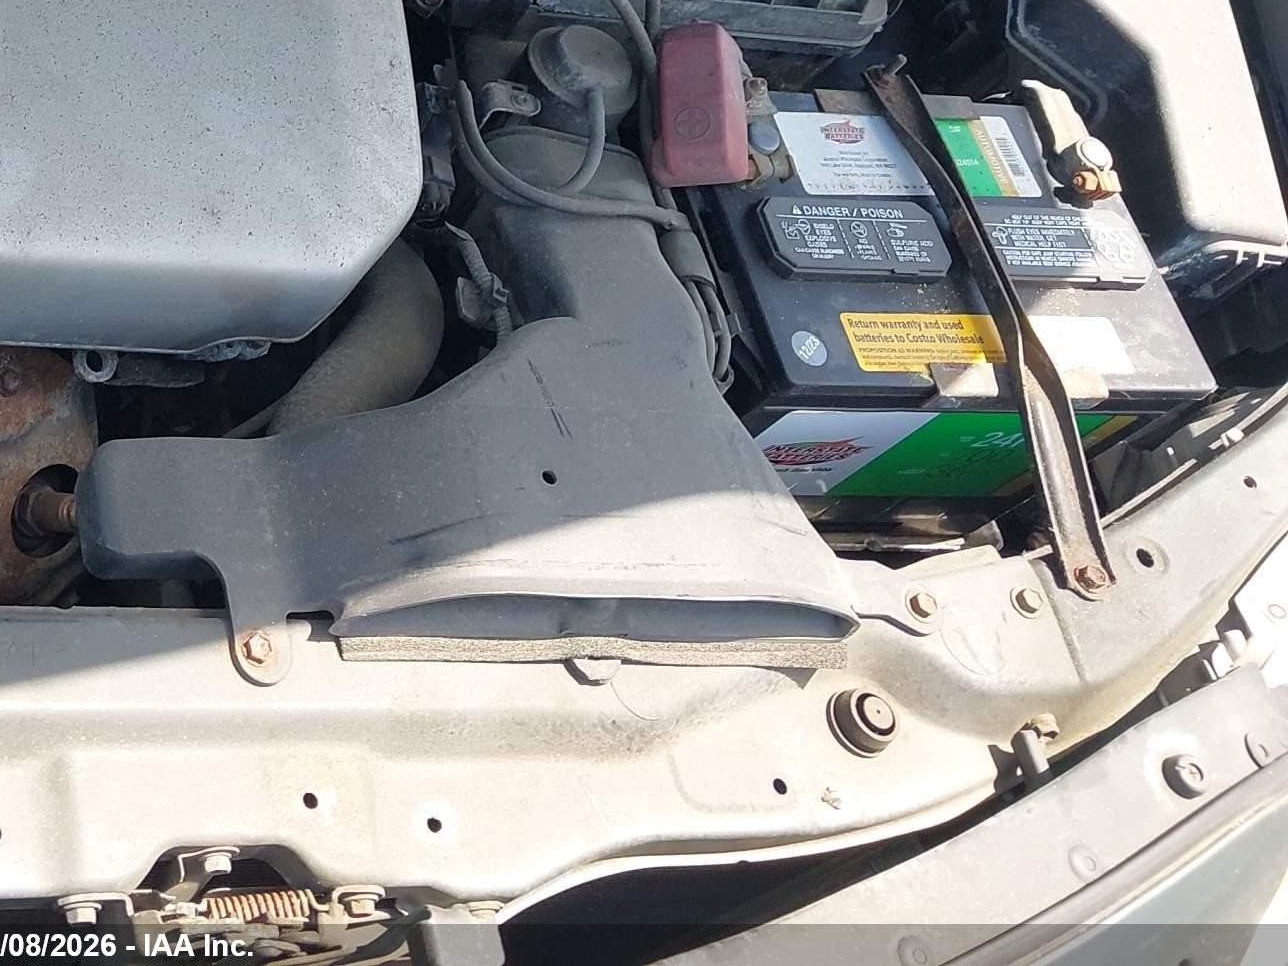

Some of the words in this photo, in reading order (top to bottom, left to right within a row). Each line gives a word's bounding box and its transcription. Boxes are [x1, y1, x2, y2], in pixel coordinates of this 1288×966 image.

[803, 205, 851, 217] DANGER
[860, 208, 904, 219] POISON
[847, 318, 879, 329] Return
[880, 320, 922, 332] warranty
[923, 320, 941, 330] and
[942, 319, 964, 330] used
[853, 332, 895, 343] batteries
[895, 334, 905, 343] to
[906, 333, 936, 344] Costco
[936, 333, 985, 345] Wholesale
[799, 336, 820, 359] 12/23
